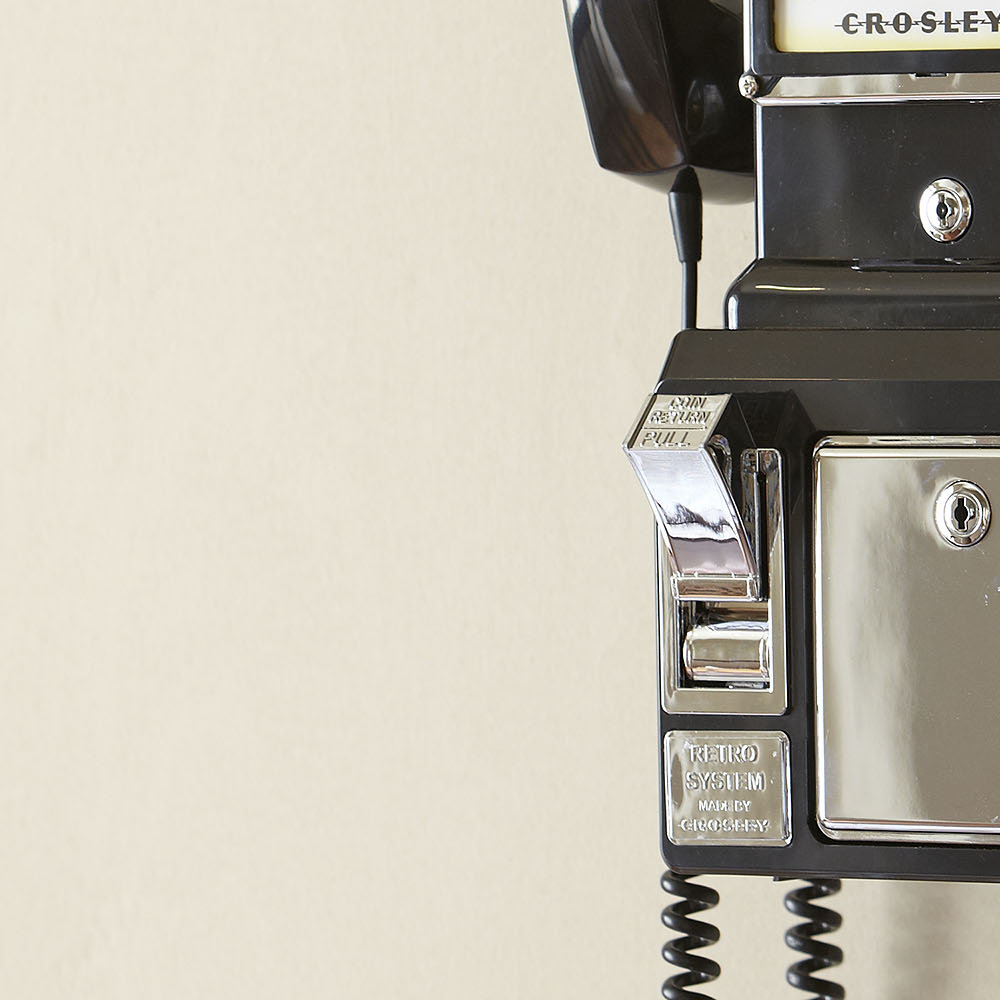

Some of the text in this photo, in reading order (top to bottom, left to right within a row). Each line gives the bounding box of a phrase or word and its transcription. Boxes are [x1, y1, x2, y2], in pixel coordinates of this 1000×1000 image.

[648, 410, 711, 424] RETURN
[640, 431, 691, 447] PULL
[689, 743, 760, 763] RETRO
[685, 771, 766, 792] SYSTEM
